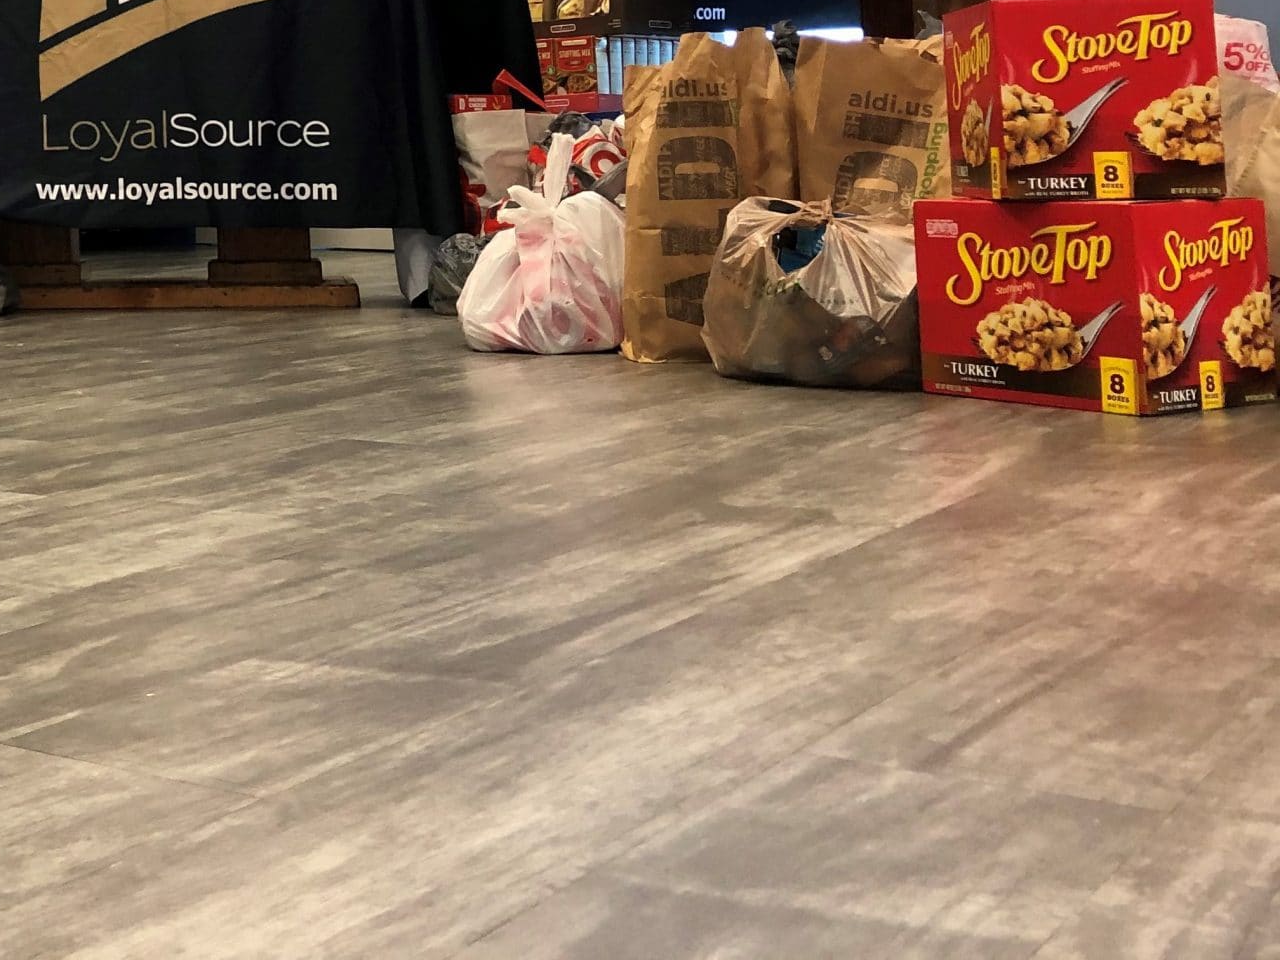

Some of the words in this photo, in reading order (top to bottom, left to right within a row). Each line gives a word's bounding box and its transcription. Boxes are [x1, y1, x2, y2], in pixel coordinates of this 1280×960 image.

[1244, 60, 1271, 72] OFF
[847, 90, 934, 119] aldi.us
[42, 110, 332, 163] LoyalSource
[1103, 165, 1120, 183] 8
[35, 177, 340, 205] www.loyalsource.com
[1027, 177, 1088, 190] TURKEY
[950, 361, 1000, 379] TURKEY
[1109, 373, 1125, 395] 8
[1204, 374, 1216, 394] 8
[1106, 394, 1131, 404] BOXES
[1159, 389, 1198, 404] TURKEY
